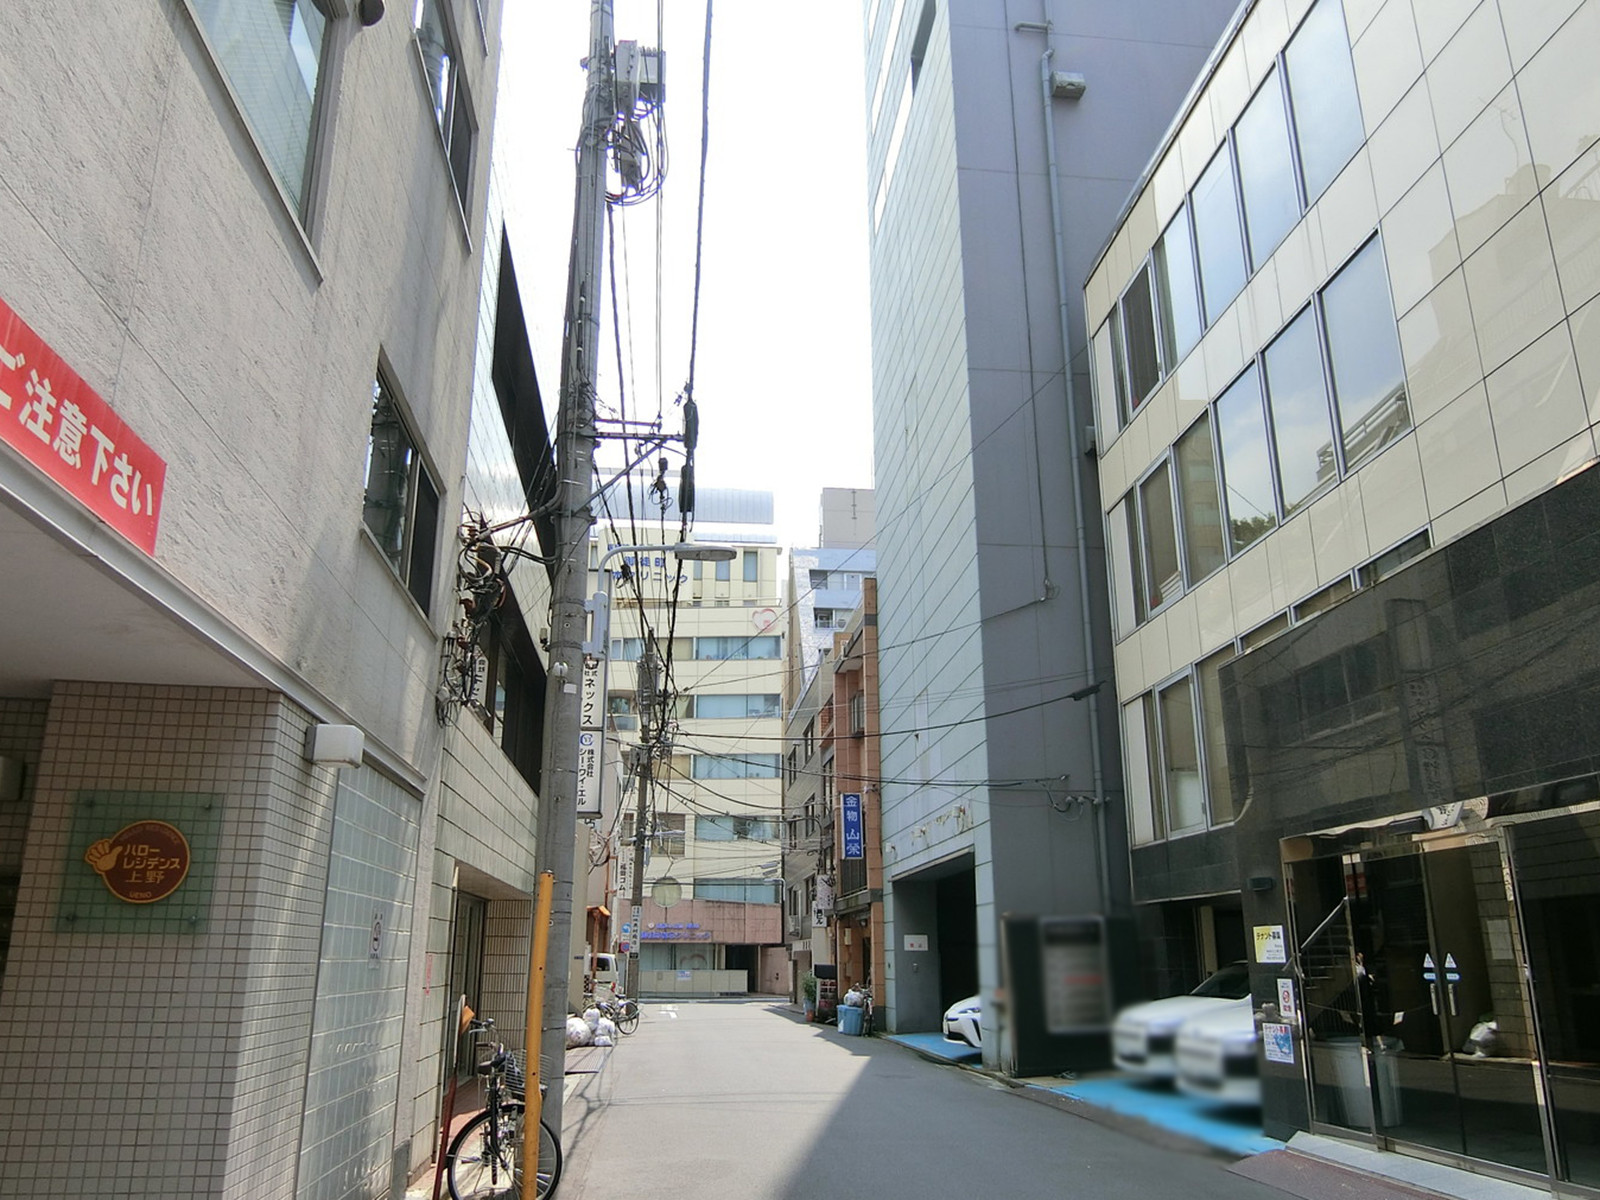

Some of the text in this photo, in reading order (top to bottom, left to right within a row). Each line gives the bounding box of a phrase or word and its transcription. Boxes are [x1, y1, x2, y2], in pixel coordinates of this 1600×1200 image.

[582, 678, 595, 725] ネックス
[123, 843, 160, 856] ハロー
[123, 857, 180, 869] レジデンス
[125, 870, 165, 884] 上野
